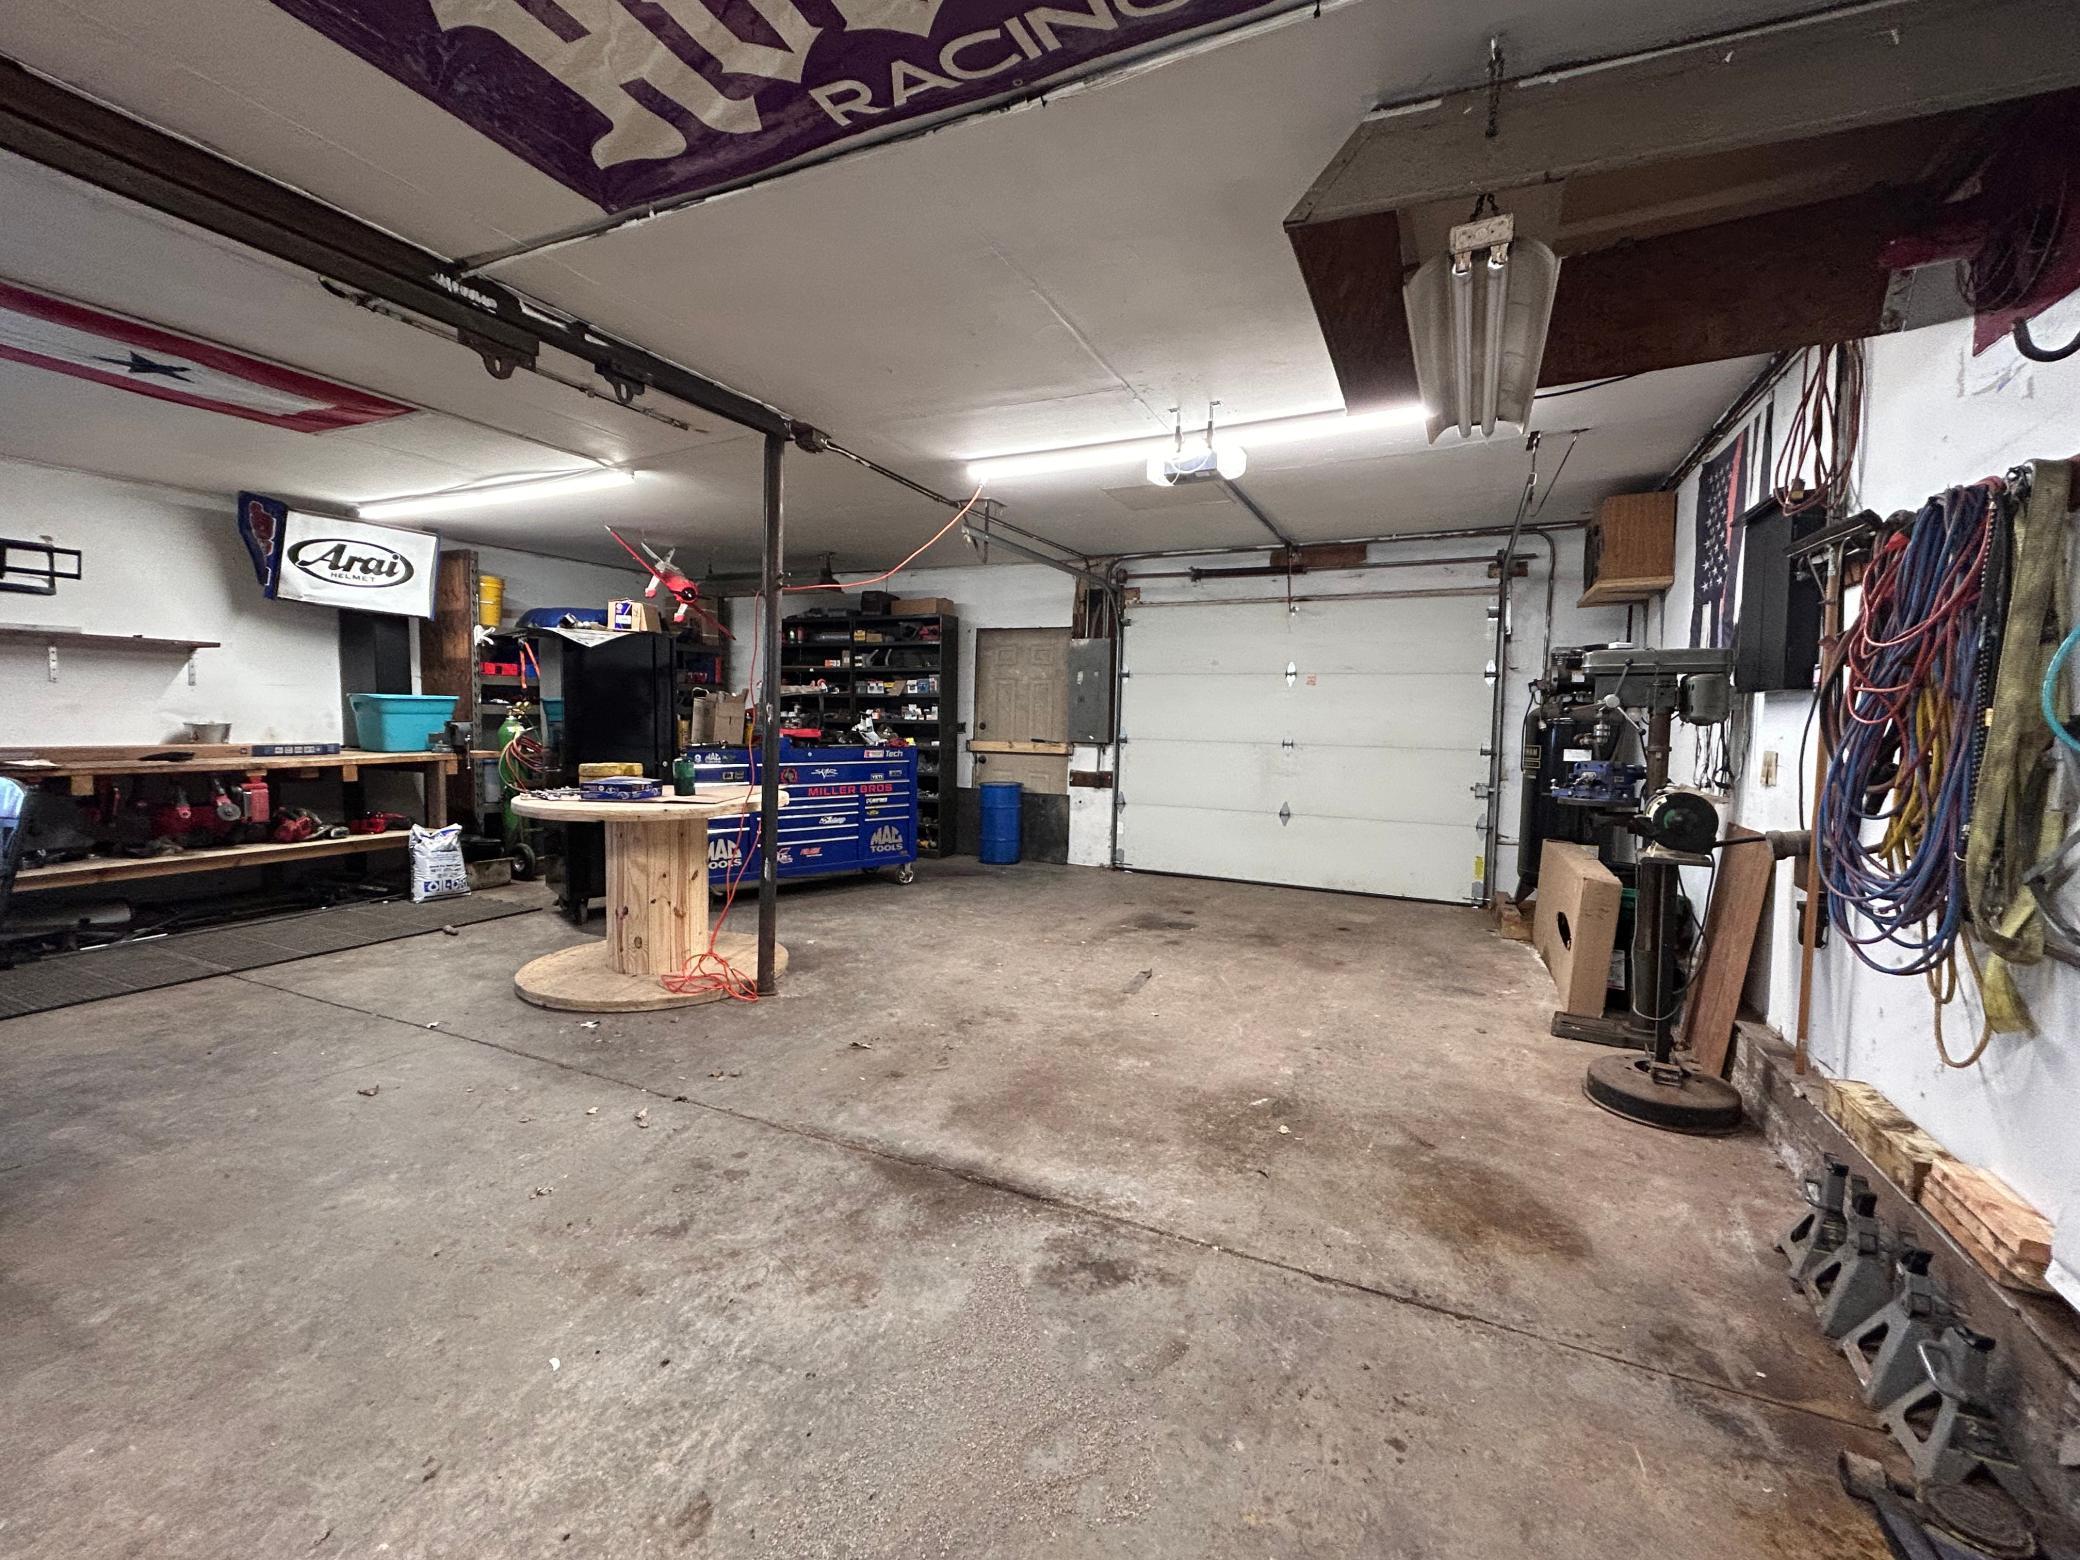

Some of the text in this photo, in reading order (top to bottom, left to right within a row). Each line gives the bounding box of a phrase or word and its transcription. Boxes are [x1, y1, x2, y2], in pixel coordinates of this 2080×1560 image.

[296, 543, 400, 577] Arai
[330, 571, 376, 582] HELMET
[886, 750, 903, 758] Tech
[808, 783, 893, 796] MILLER BROS
[870, 825, 903, 845] MAC
[870, 843, 904, 853] TOOLS
